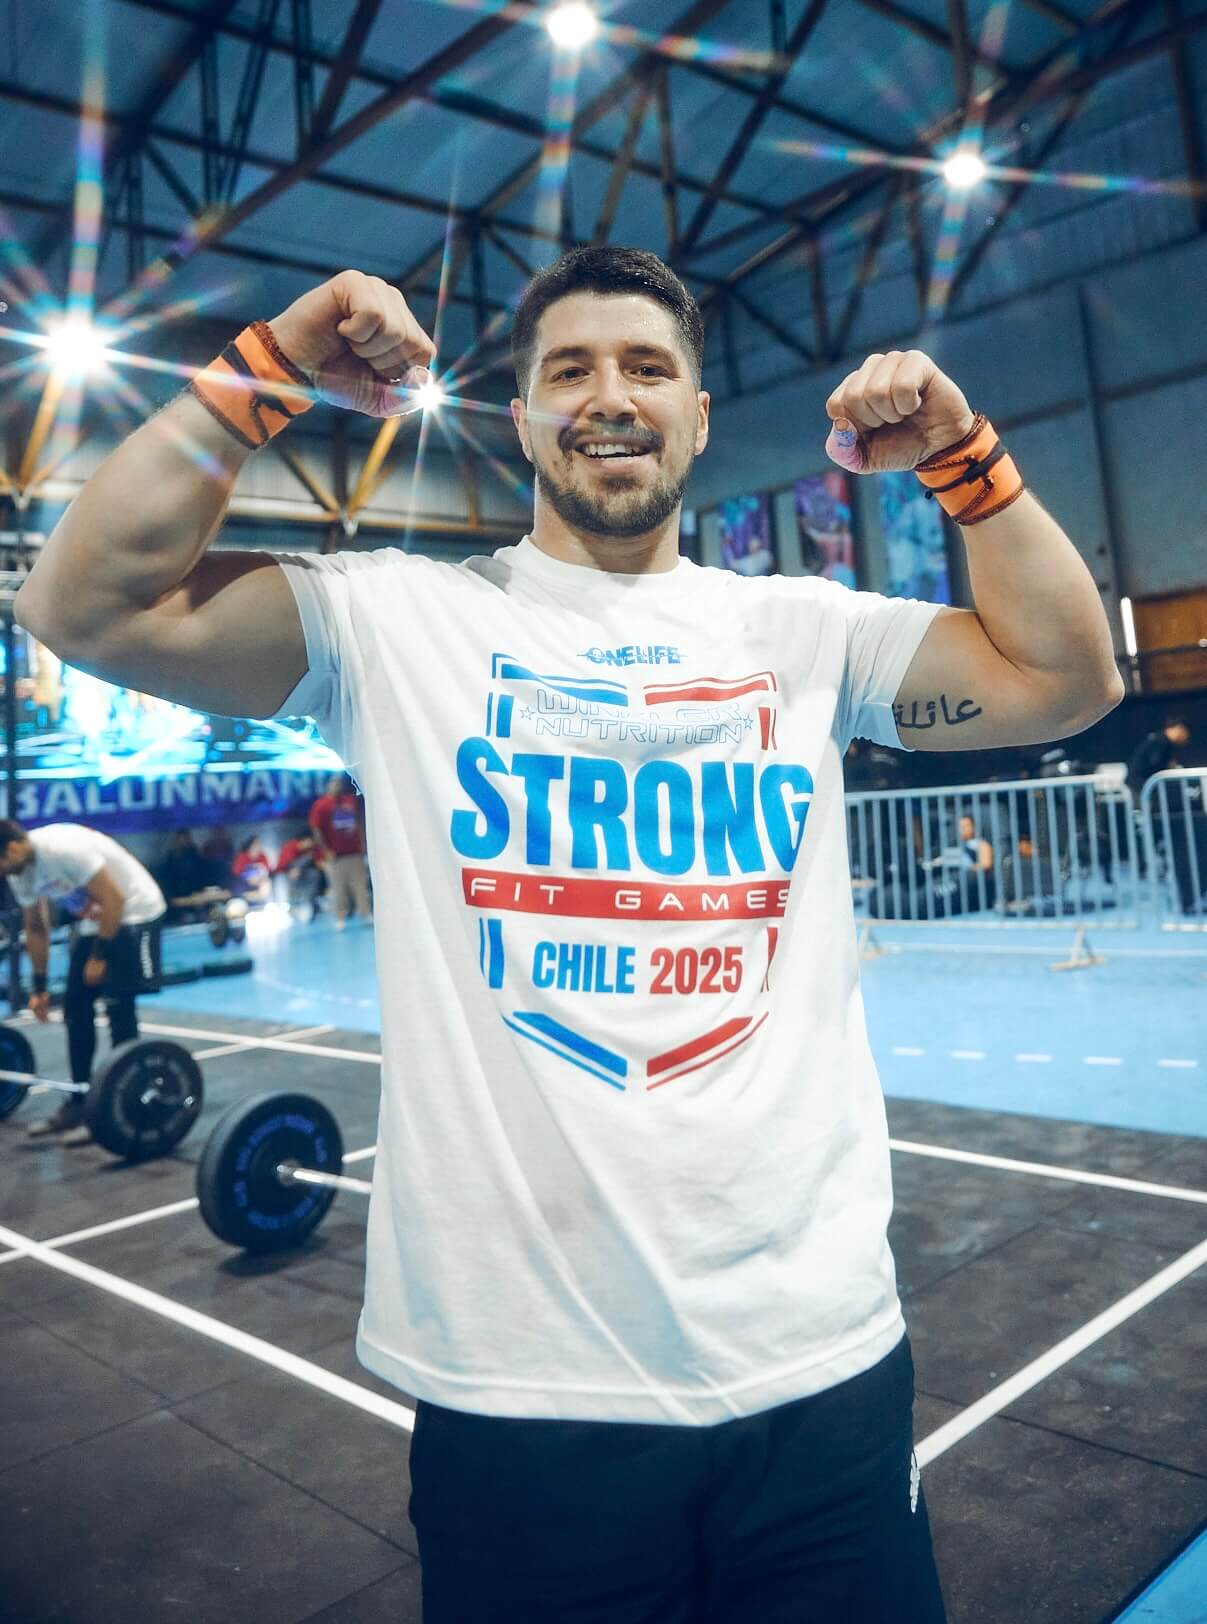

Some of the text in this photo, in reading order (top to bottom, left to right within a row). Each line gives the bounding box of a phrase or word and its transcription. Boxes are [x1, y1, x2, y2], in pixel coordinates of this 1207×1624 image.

[583, 645, 682, 667] ONELIFE
[535, 717, 745, 745] NUTRITION
[0, 767, 329, 821] BALONMAN
[450, 736, 814, 877] STRONG
[470, 877, 789, 911] FIT GAMES
[532, 940, 743, 995] CHILE 2025
